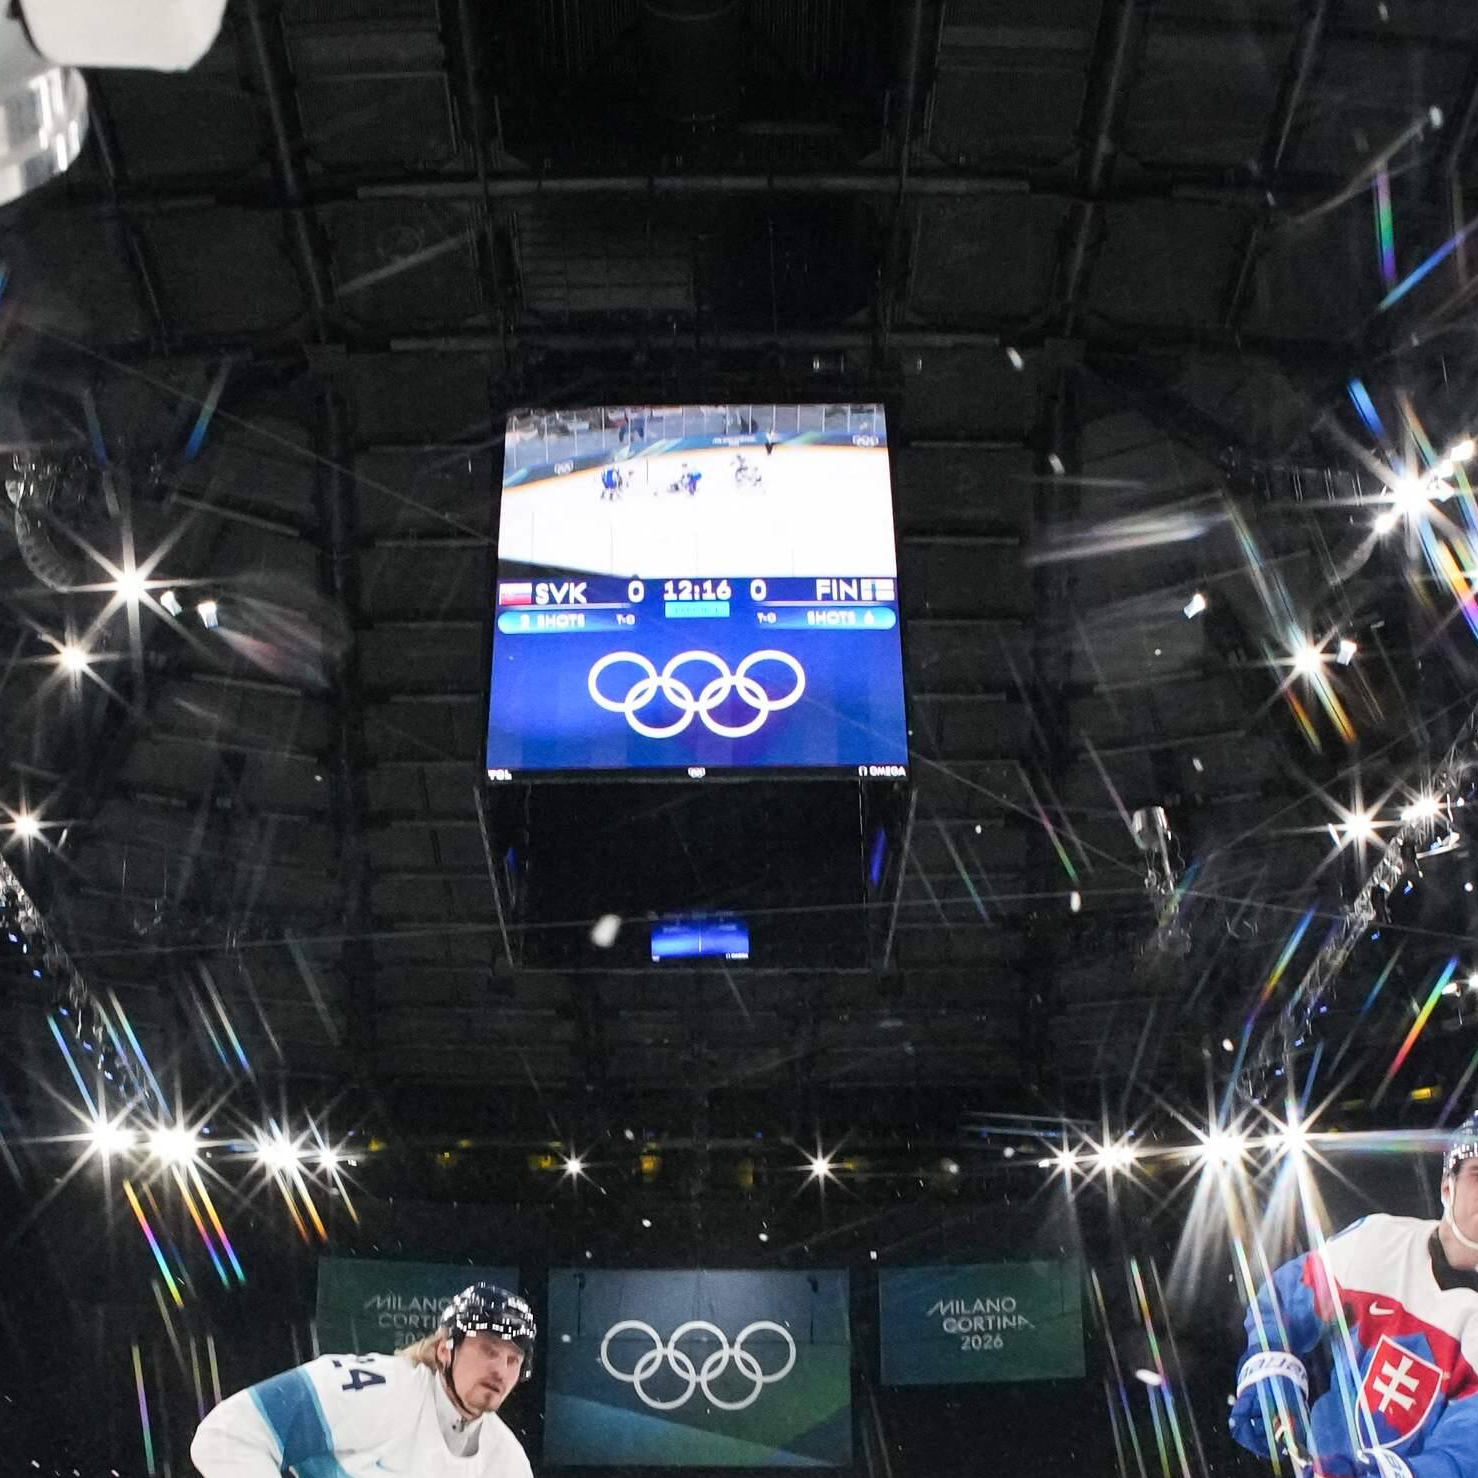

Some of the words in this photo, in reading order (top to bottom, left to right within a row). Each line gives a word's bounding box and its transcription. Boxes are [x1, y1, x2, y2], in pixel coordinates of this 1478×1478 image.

[535, 581, 588, 604] SVK
[627, 580, 645, 603] 0
[663, 579, 732, 601] 12:16
[750, 578, 767, 601] 0
[815, 578, 858, 601] FIN
[926, 1297, 1017, 1317] MILANO
[379, 1311, 442, 1329] CORTI
[942, 1314, 1035, 1334] CORTINA
[961, 1333, 1004, 1351] 2026
